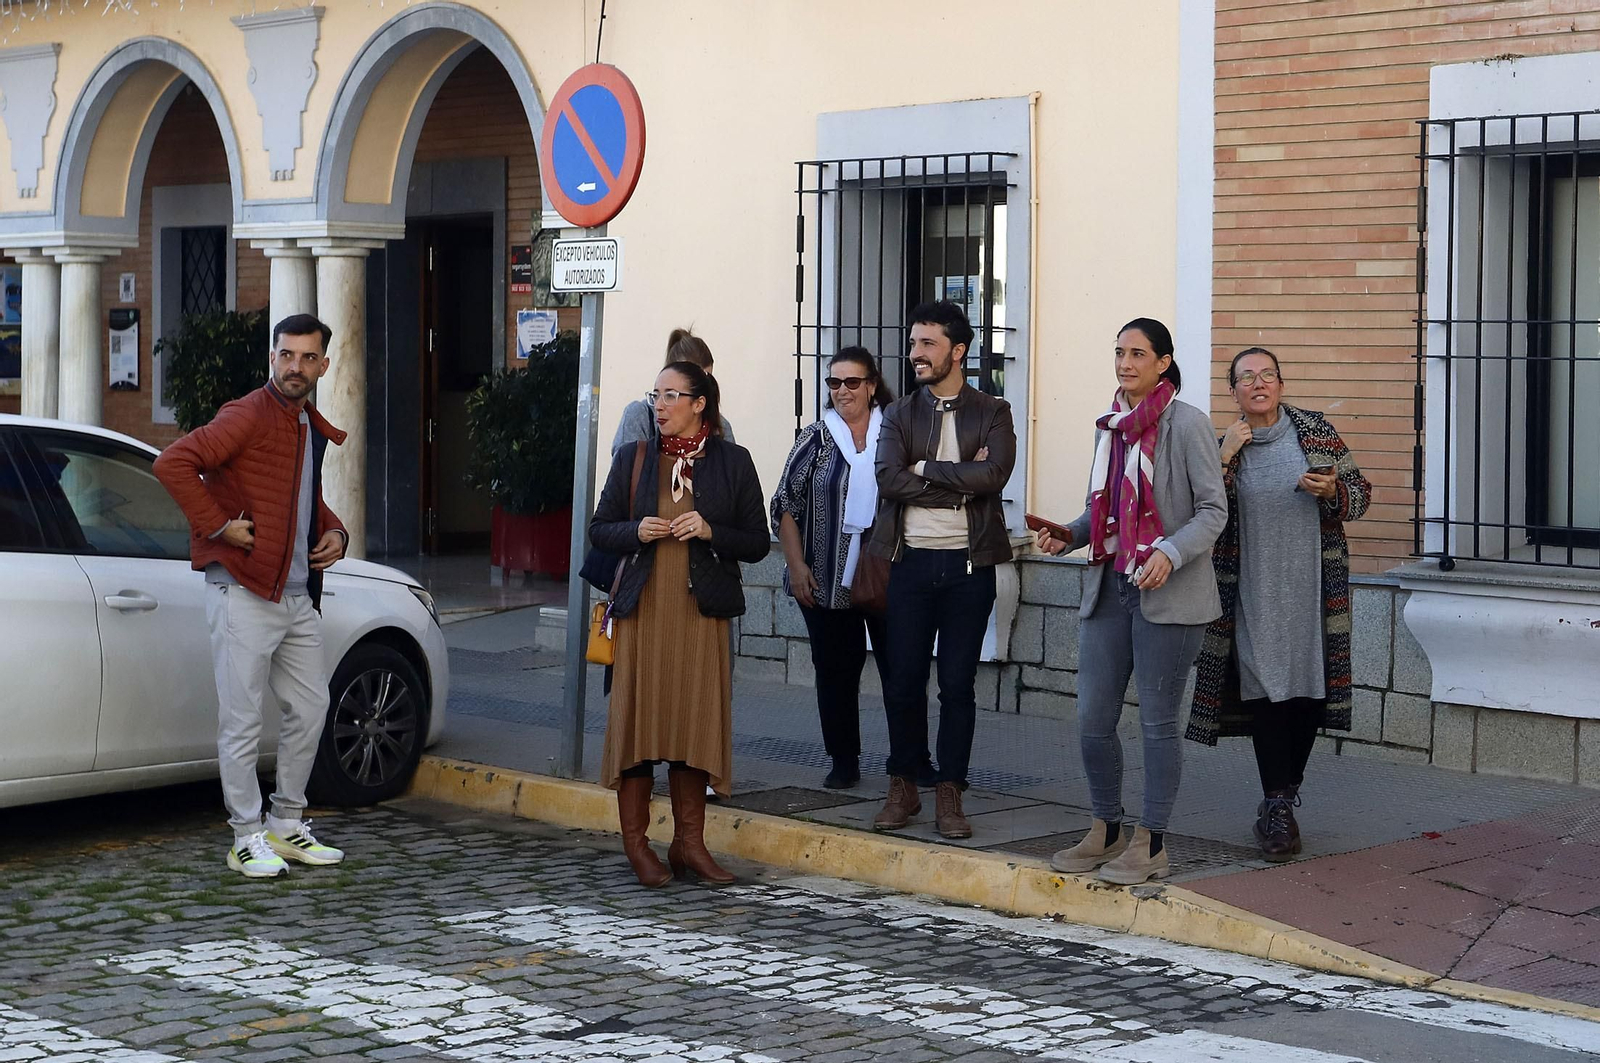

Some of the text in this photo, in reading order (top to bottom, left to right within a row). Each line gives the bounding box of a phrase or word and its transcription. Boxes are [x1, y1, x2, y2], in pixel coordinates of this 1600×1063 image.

[556, 245, 615, 261] EXCEPTO VEHICULOS
[564, 268, 605, 284] AUTORIZADOS
